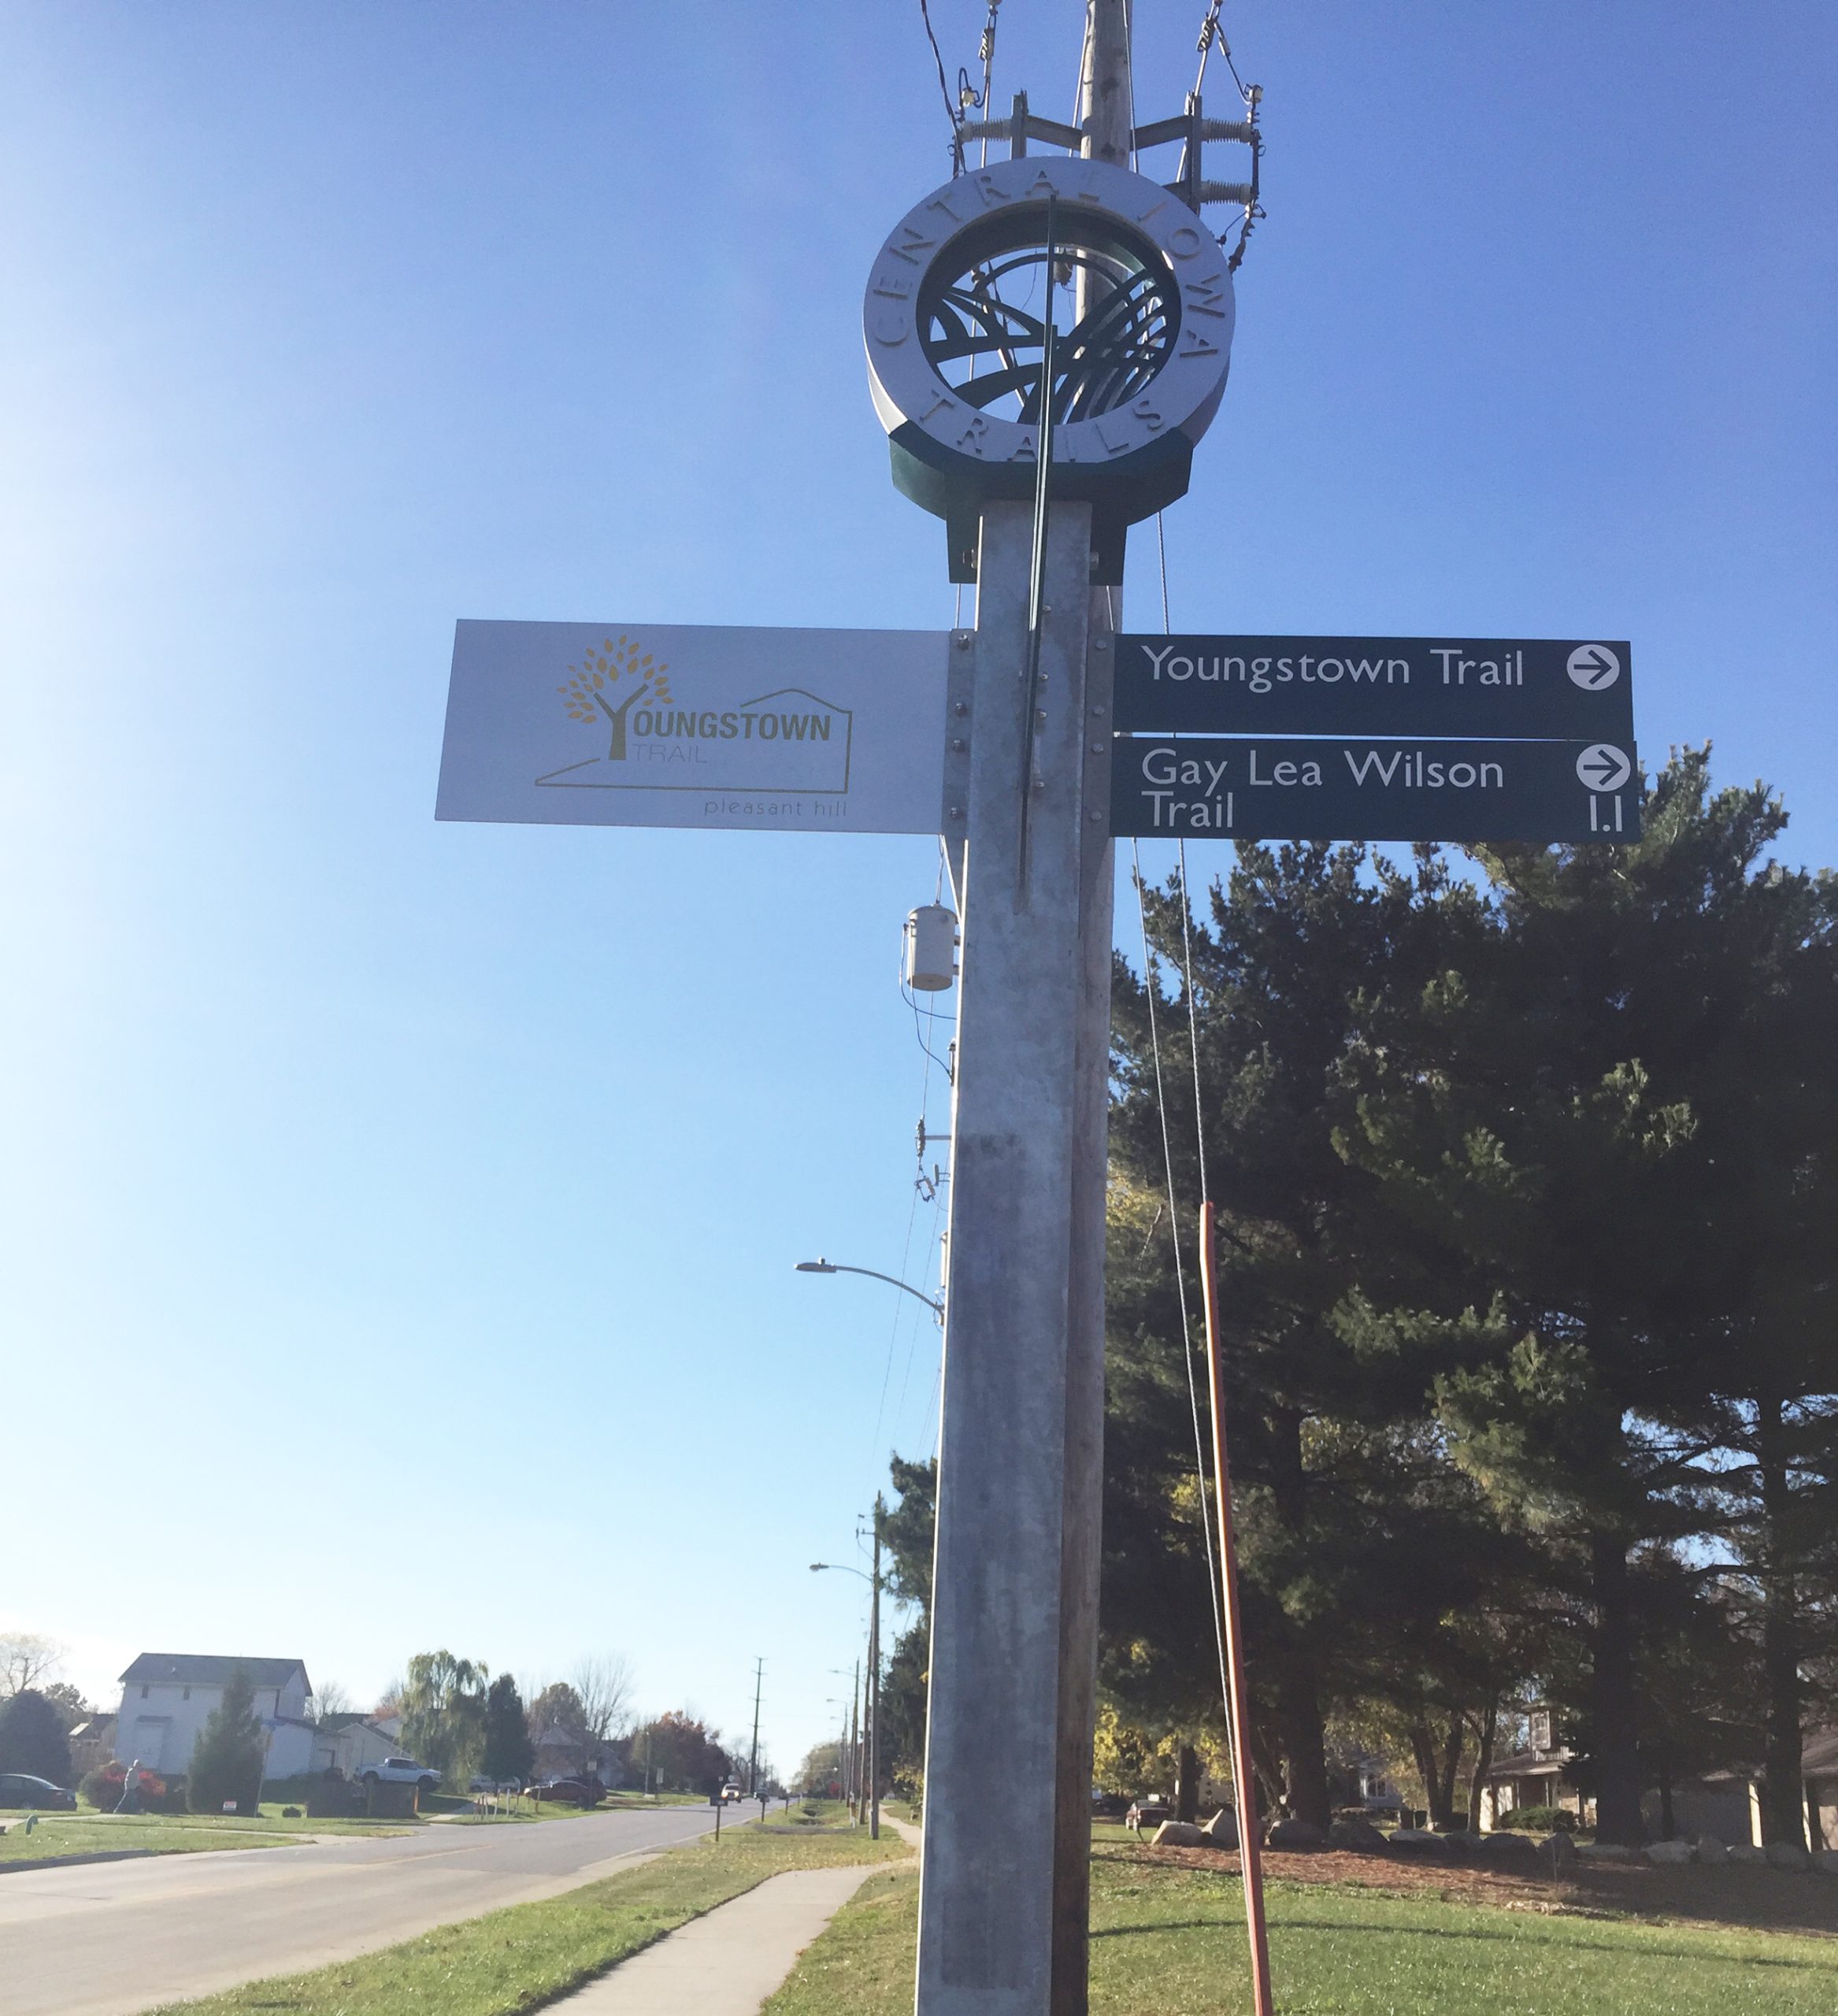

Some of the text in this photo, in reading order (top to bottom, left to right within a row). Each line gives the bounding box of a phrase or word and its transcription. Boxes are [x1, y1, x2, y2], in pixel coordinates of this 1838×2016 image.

[1136, 200, 1225, 358] IOWA
[919, 389, 1166, 463] TRAILS
[1140, 645, 1523, 694] Youngstown Trail
[594, 683, 832, 761] YOUNGSTOWN
[632, 743, 709, 764] TRAIL
[1142, 748, 1503, 797] Gay Lea Wilson
[704, 798, 848, 817] pleasant hill
[1141, 791, 1233, 828] Trail
